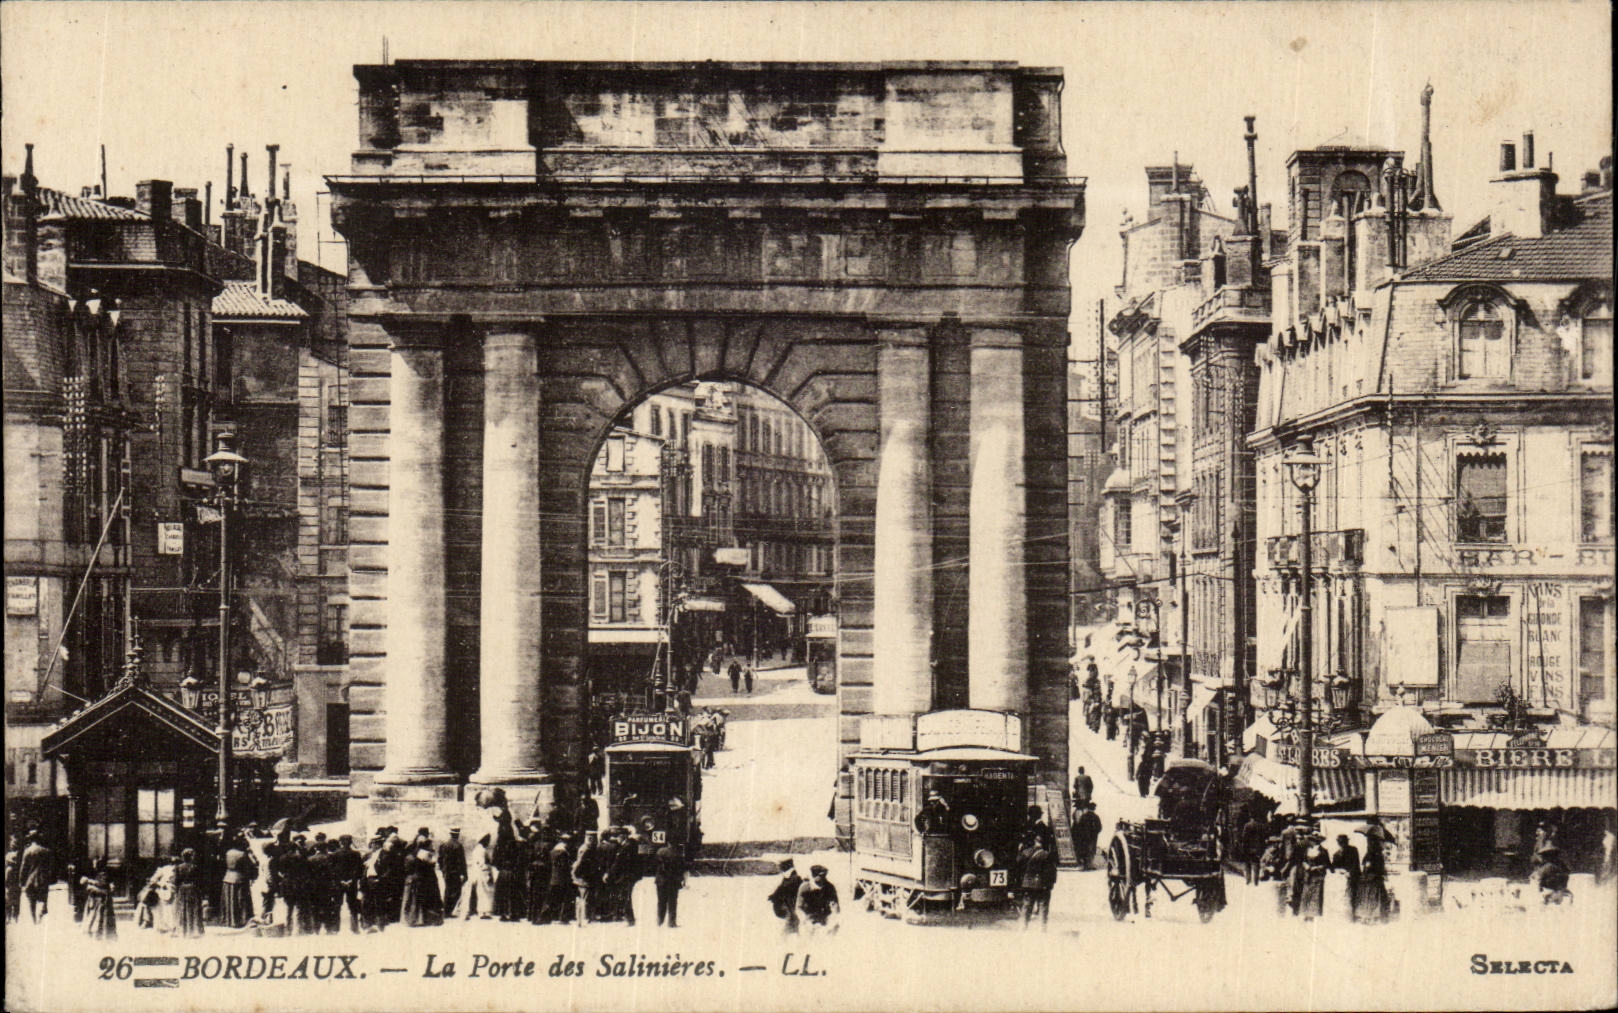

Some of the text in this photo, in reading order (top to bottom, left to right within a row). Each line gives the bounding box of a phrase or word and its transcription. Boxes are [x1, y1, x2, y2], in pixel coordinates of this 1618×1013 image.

[1460, 549, 1537, 567] BAR
[1527, 582, 1562, 598] VINS
[614, 720, 684, 737] BIJON
[992, 871, 1005, 885] 73
